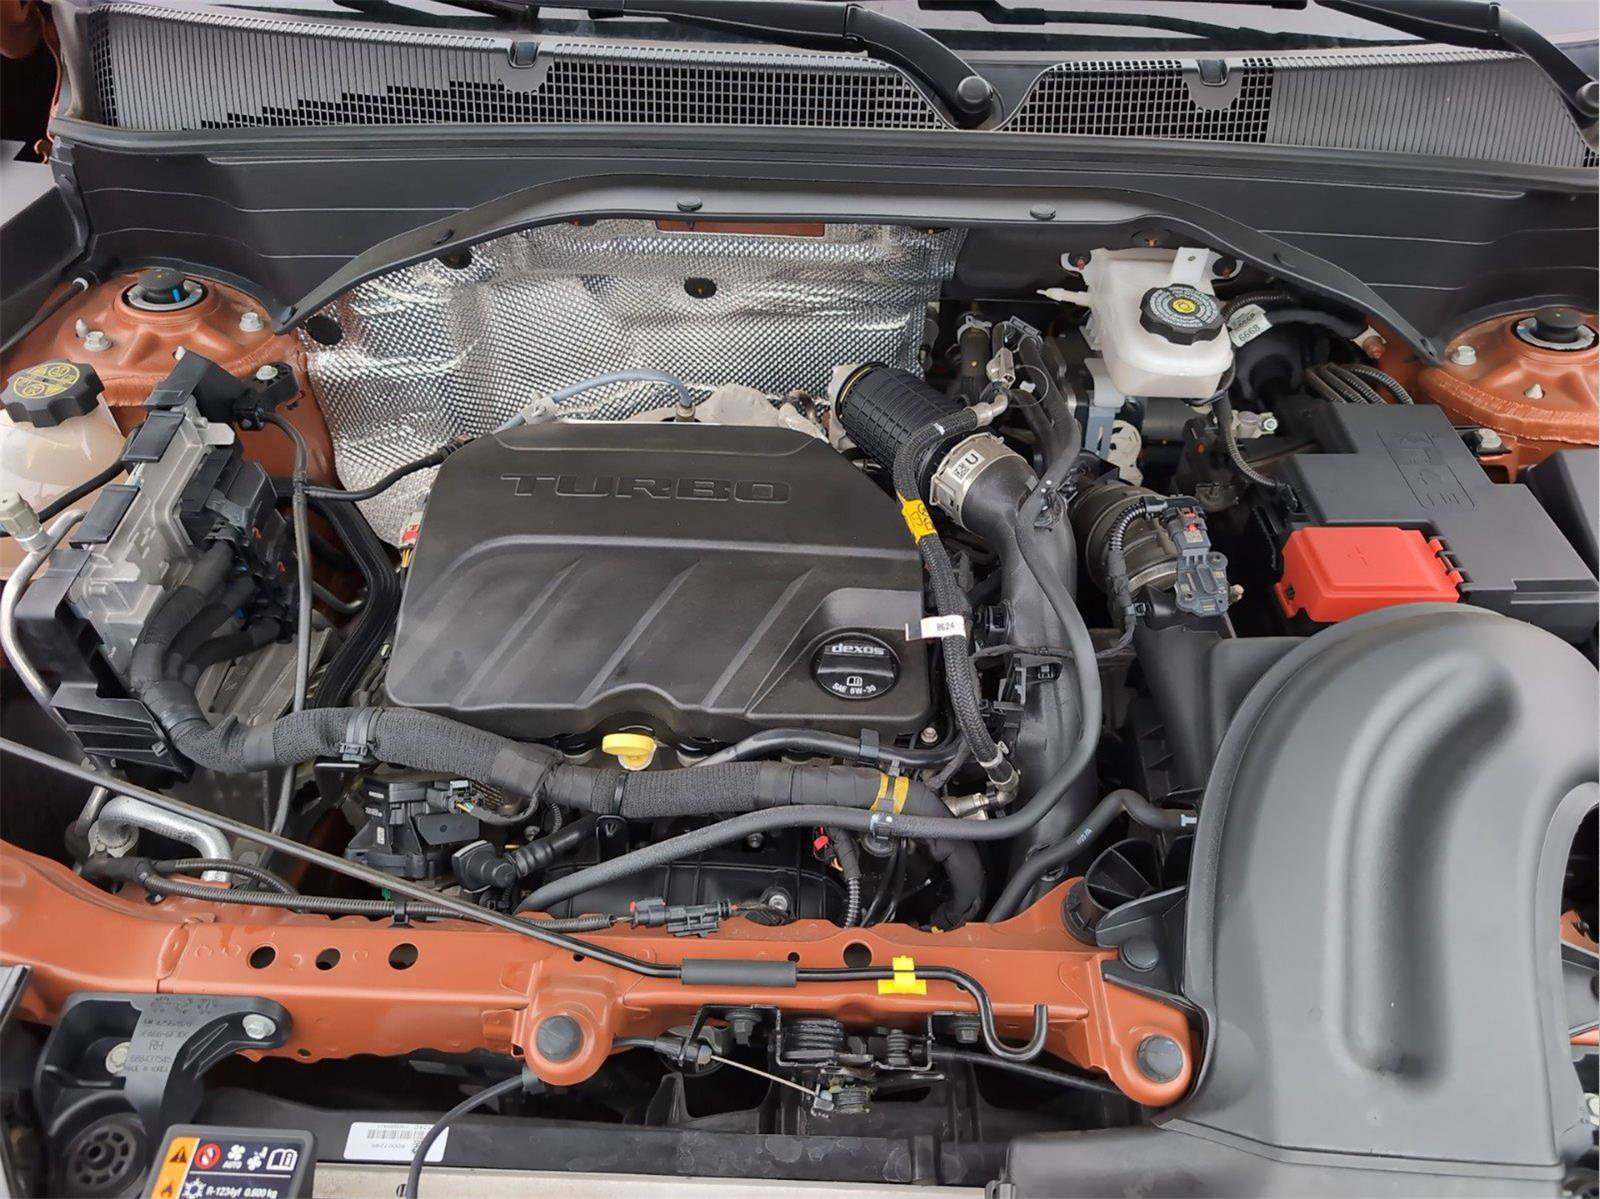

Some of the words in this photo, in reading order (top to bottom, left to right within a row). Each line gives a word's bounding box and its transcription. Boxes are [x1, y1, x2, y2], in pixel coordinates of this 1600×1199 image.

[964, 453, 979, 465] U
[500, 473, 792, 504] TURBO
[832, 643, 886, 655] dexos
[832, 682, 847, 693] SAE
[849, 684, 877, 695] 5W-30
[149, 1040, 164, 1050] RH
[222, 1160, 242, 1170] AUTO
[205, 1185, 242, 1198] R-1234yf
[267, 1187, 278, 1199] kg
